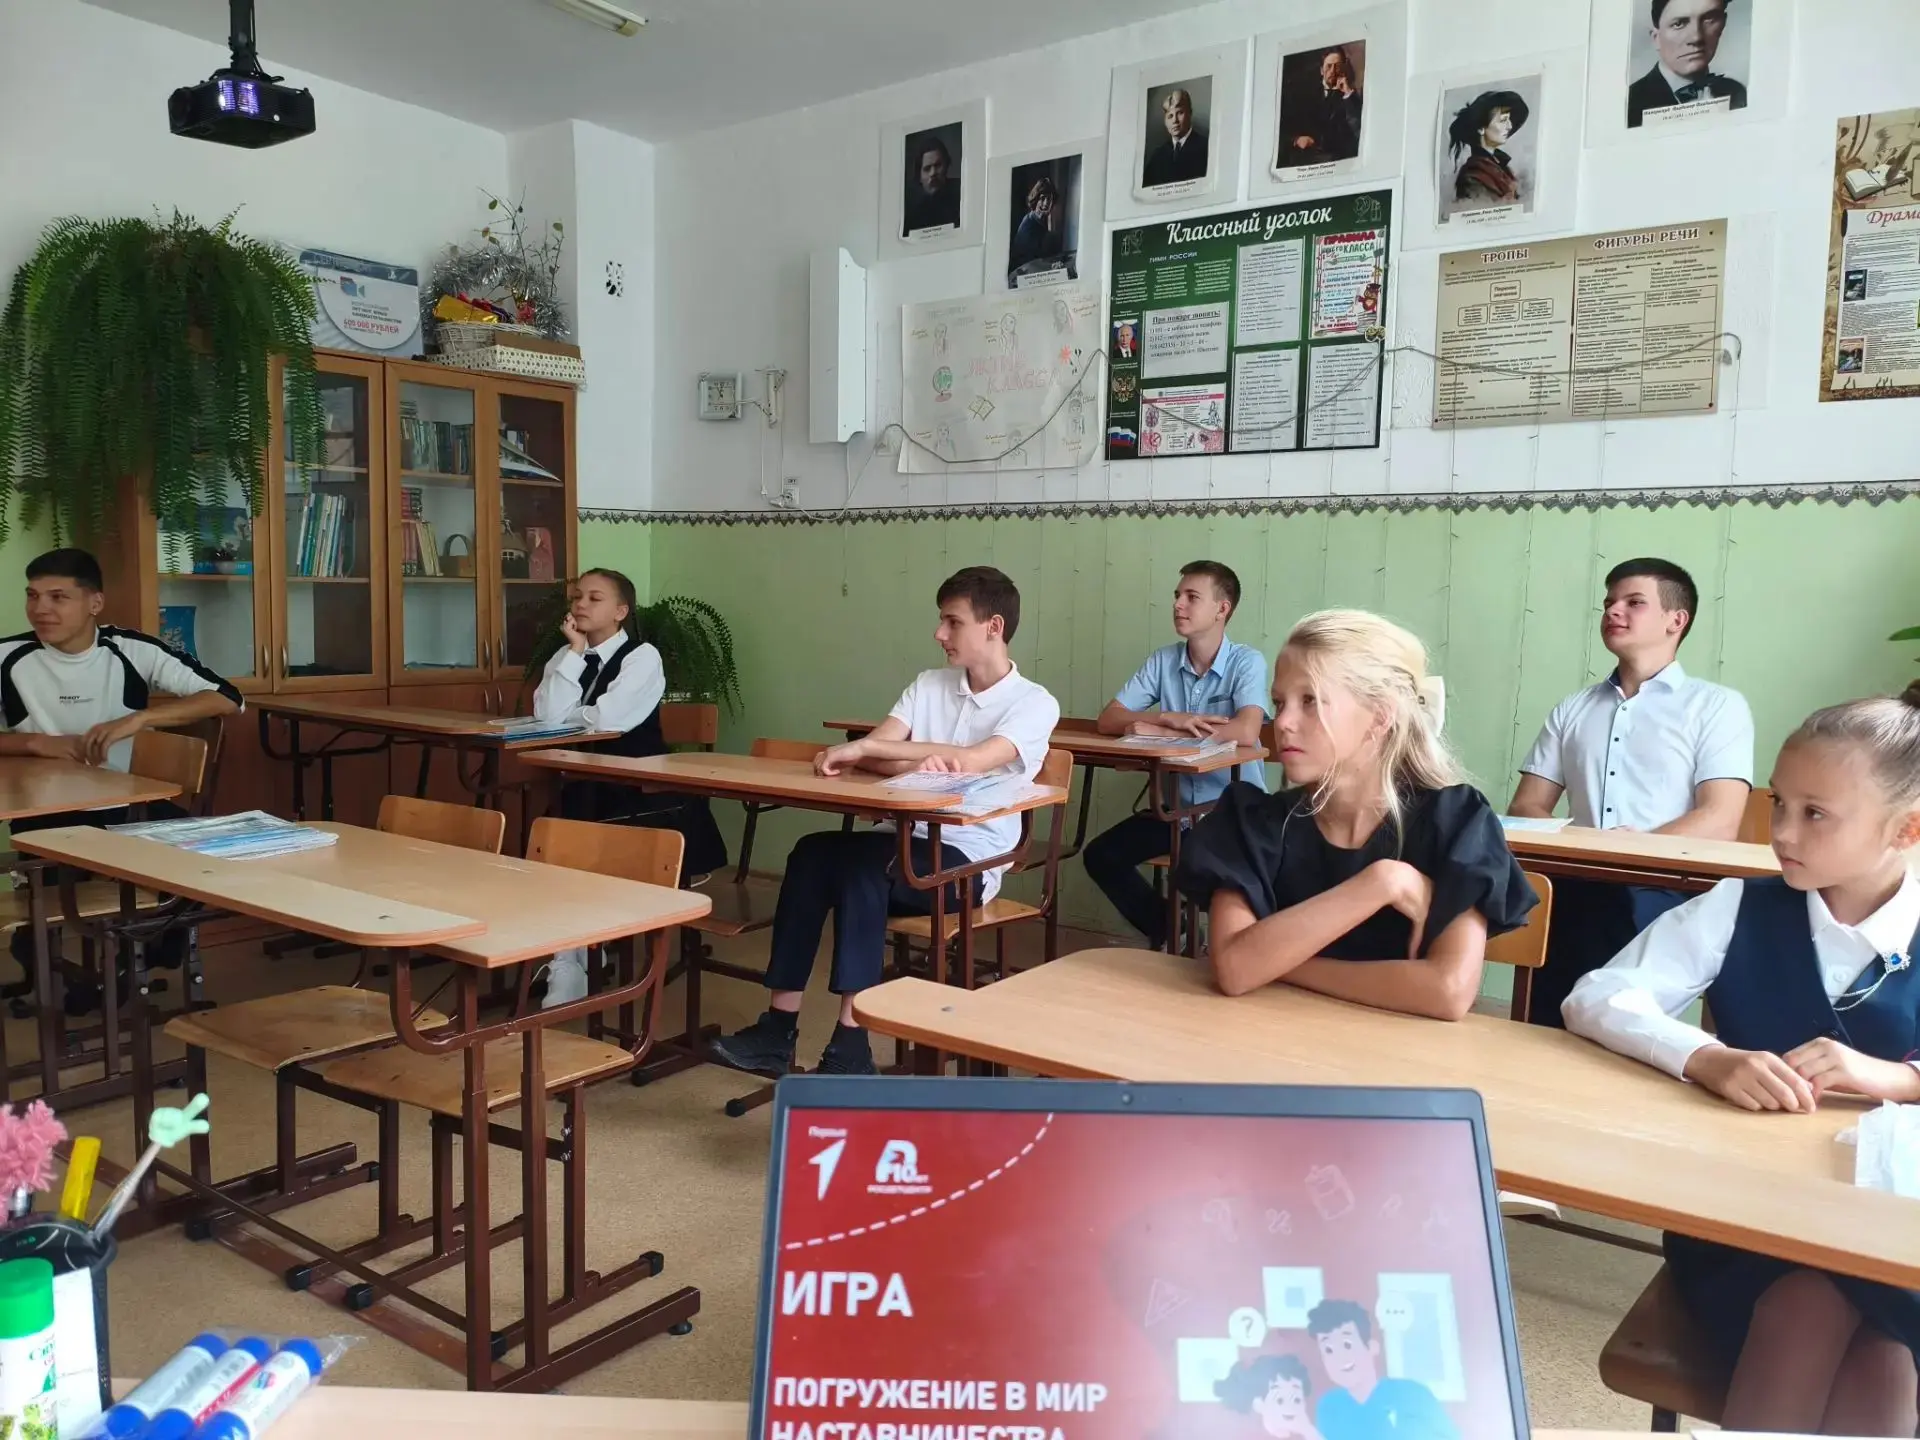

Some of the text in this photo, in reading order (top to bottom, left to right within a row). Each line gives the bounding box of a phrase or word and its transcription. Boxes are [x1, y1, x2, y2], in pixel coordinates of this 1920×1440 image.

[1167, 206, 1333, 245] Классный уголок
[1343, 242, 1375, 253] КЛАССА
[1594, 228, 1699, 250] ФИГУРЫ РЕЧИ
[1169, 251, 1198, 260] РОССИИ
[1481, 249, 1529, 263] ТРОПЫ
[1152, 315, 1166, 325] При
[1167, 313, 1191, 323] пожаре
[782, 1271, 914, 1317] ИГРА
[773, 1376, 1109, 1412] ПОГРУЖЕНИЕ В МИР
